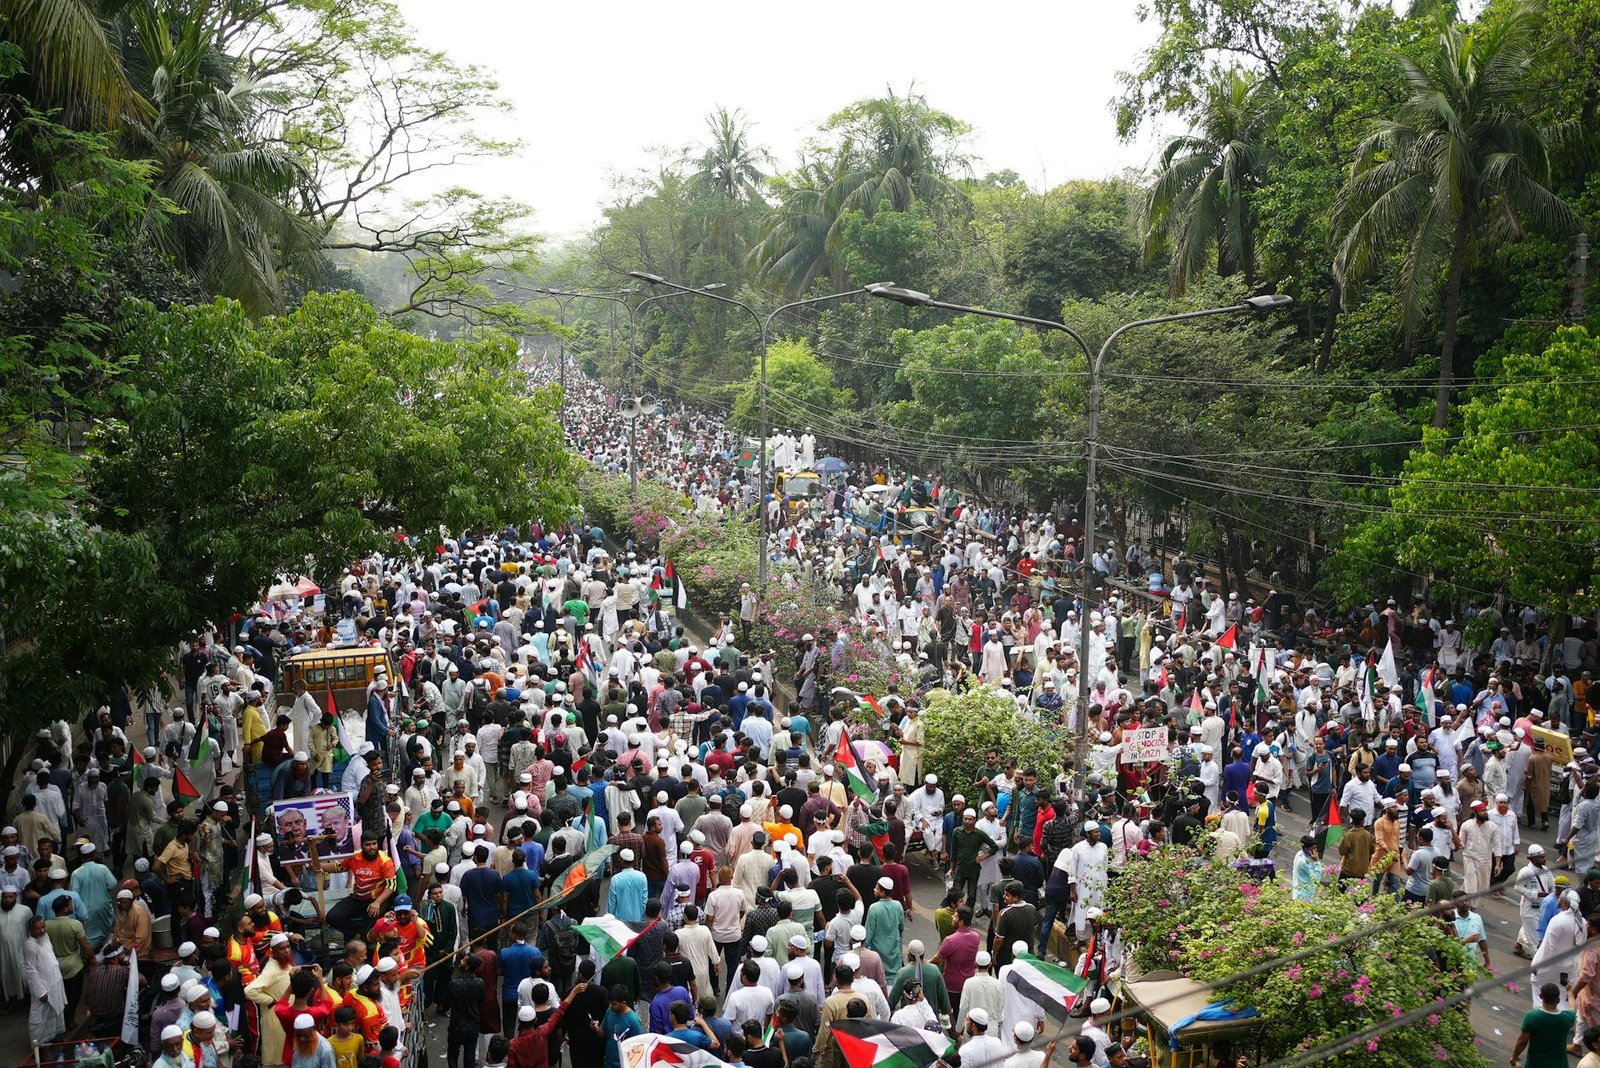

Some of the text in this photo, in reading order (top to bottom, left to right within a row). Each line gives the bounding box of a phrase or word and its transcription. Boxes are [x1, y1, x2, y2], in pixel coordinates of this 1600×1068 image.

[1137, 731, 1157, 740] STOP
[1129, 739, 1167, 751] GENOCIDE
[1130, 749, 1161, 760] IN GAZA
